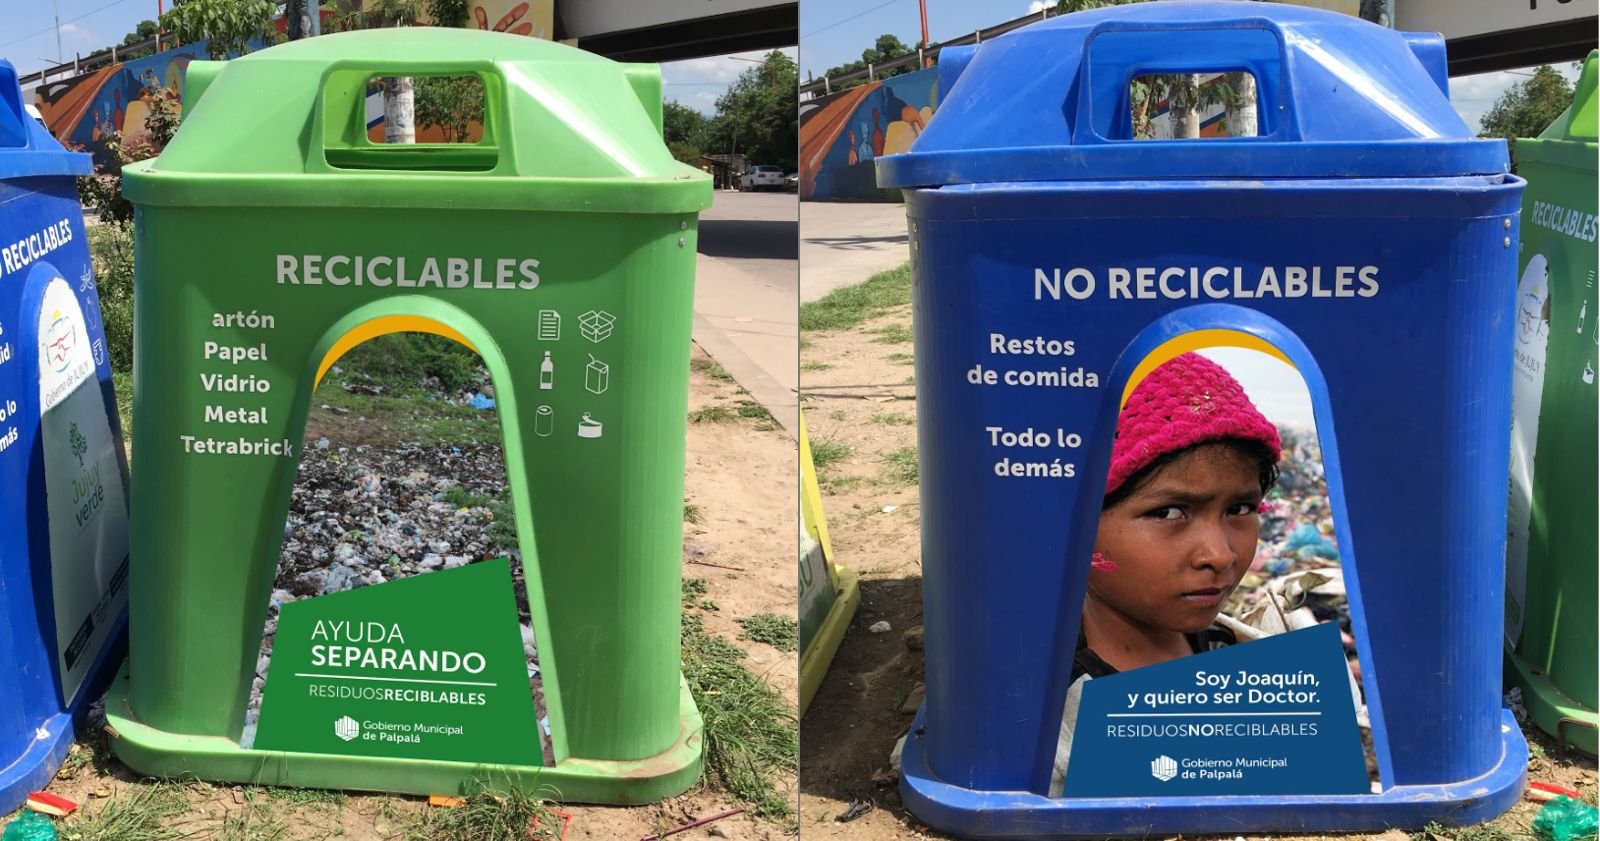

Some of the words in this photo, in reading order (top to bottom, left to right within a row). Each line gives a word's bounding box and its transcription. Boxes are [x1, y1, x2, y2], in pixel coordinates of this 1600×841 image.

[1531, 200, 1598, 243] RECICLABLES
[2, 218, 73, 275] RECICLABLES
[276, 254, 541, 290] RECICLABLES
[1034, 267, 1096, 300] NO
[1108, 265, 1380, 299] RECICLABLES
[211, 310, 275, 329] artón
[204, 341, 268, 364] Papel
[989, 333, 1076, 356] Restos
[200, 373, 270, 394] Vidrio
[966, 364, 998, 385] de
[1003, 365, 1099, 388] comida
[6, 400, 17, 417] lo
[204, 405, 268, 424] Metal
[180, 435, 293, 457] Tetrabrick
[985, 426, 1051, 448] Todo
[1057, 428, 1082, 448] lo
[994, 457, 1076, 478] demás
[71, 461, 100, 505] Jujuy
[75, 485, 104, 528] verde
[311, 619, 405, 644] AYUDA
[311, 645, 486, 674] SEPARANDO
[1195, 670, 1231, 690] Soy
[1236, 670, 1320, 689] Joaquín,
[1127, 693, 1139, 708] y
[1144, 689, 1208, 708] quiero
[1213, 691, 1243, 704] ser
[1248, 688, 1321, 704] Doctor.
[363, 720, 411, 732] Gobierno
[414, 723, 464, 736] Municipal
[363, 731, 377, 741] de
[379, 732, 421, 744] Palpalá
[1181, 757, 1233, 768] Gobierno
[1235, 757, 1288, 770] Municipal
[1181, 769, 1197, 779] de
[1199, 769, 1243, 781] Palpalá
